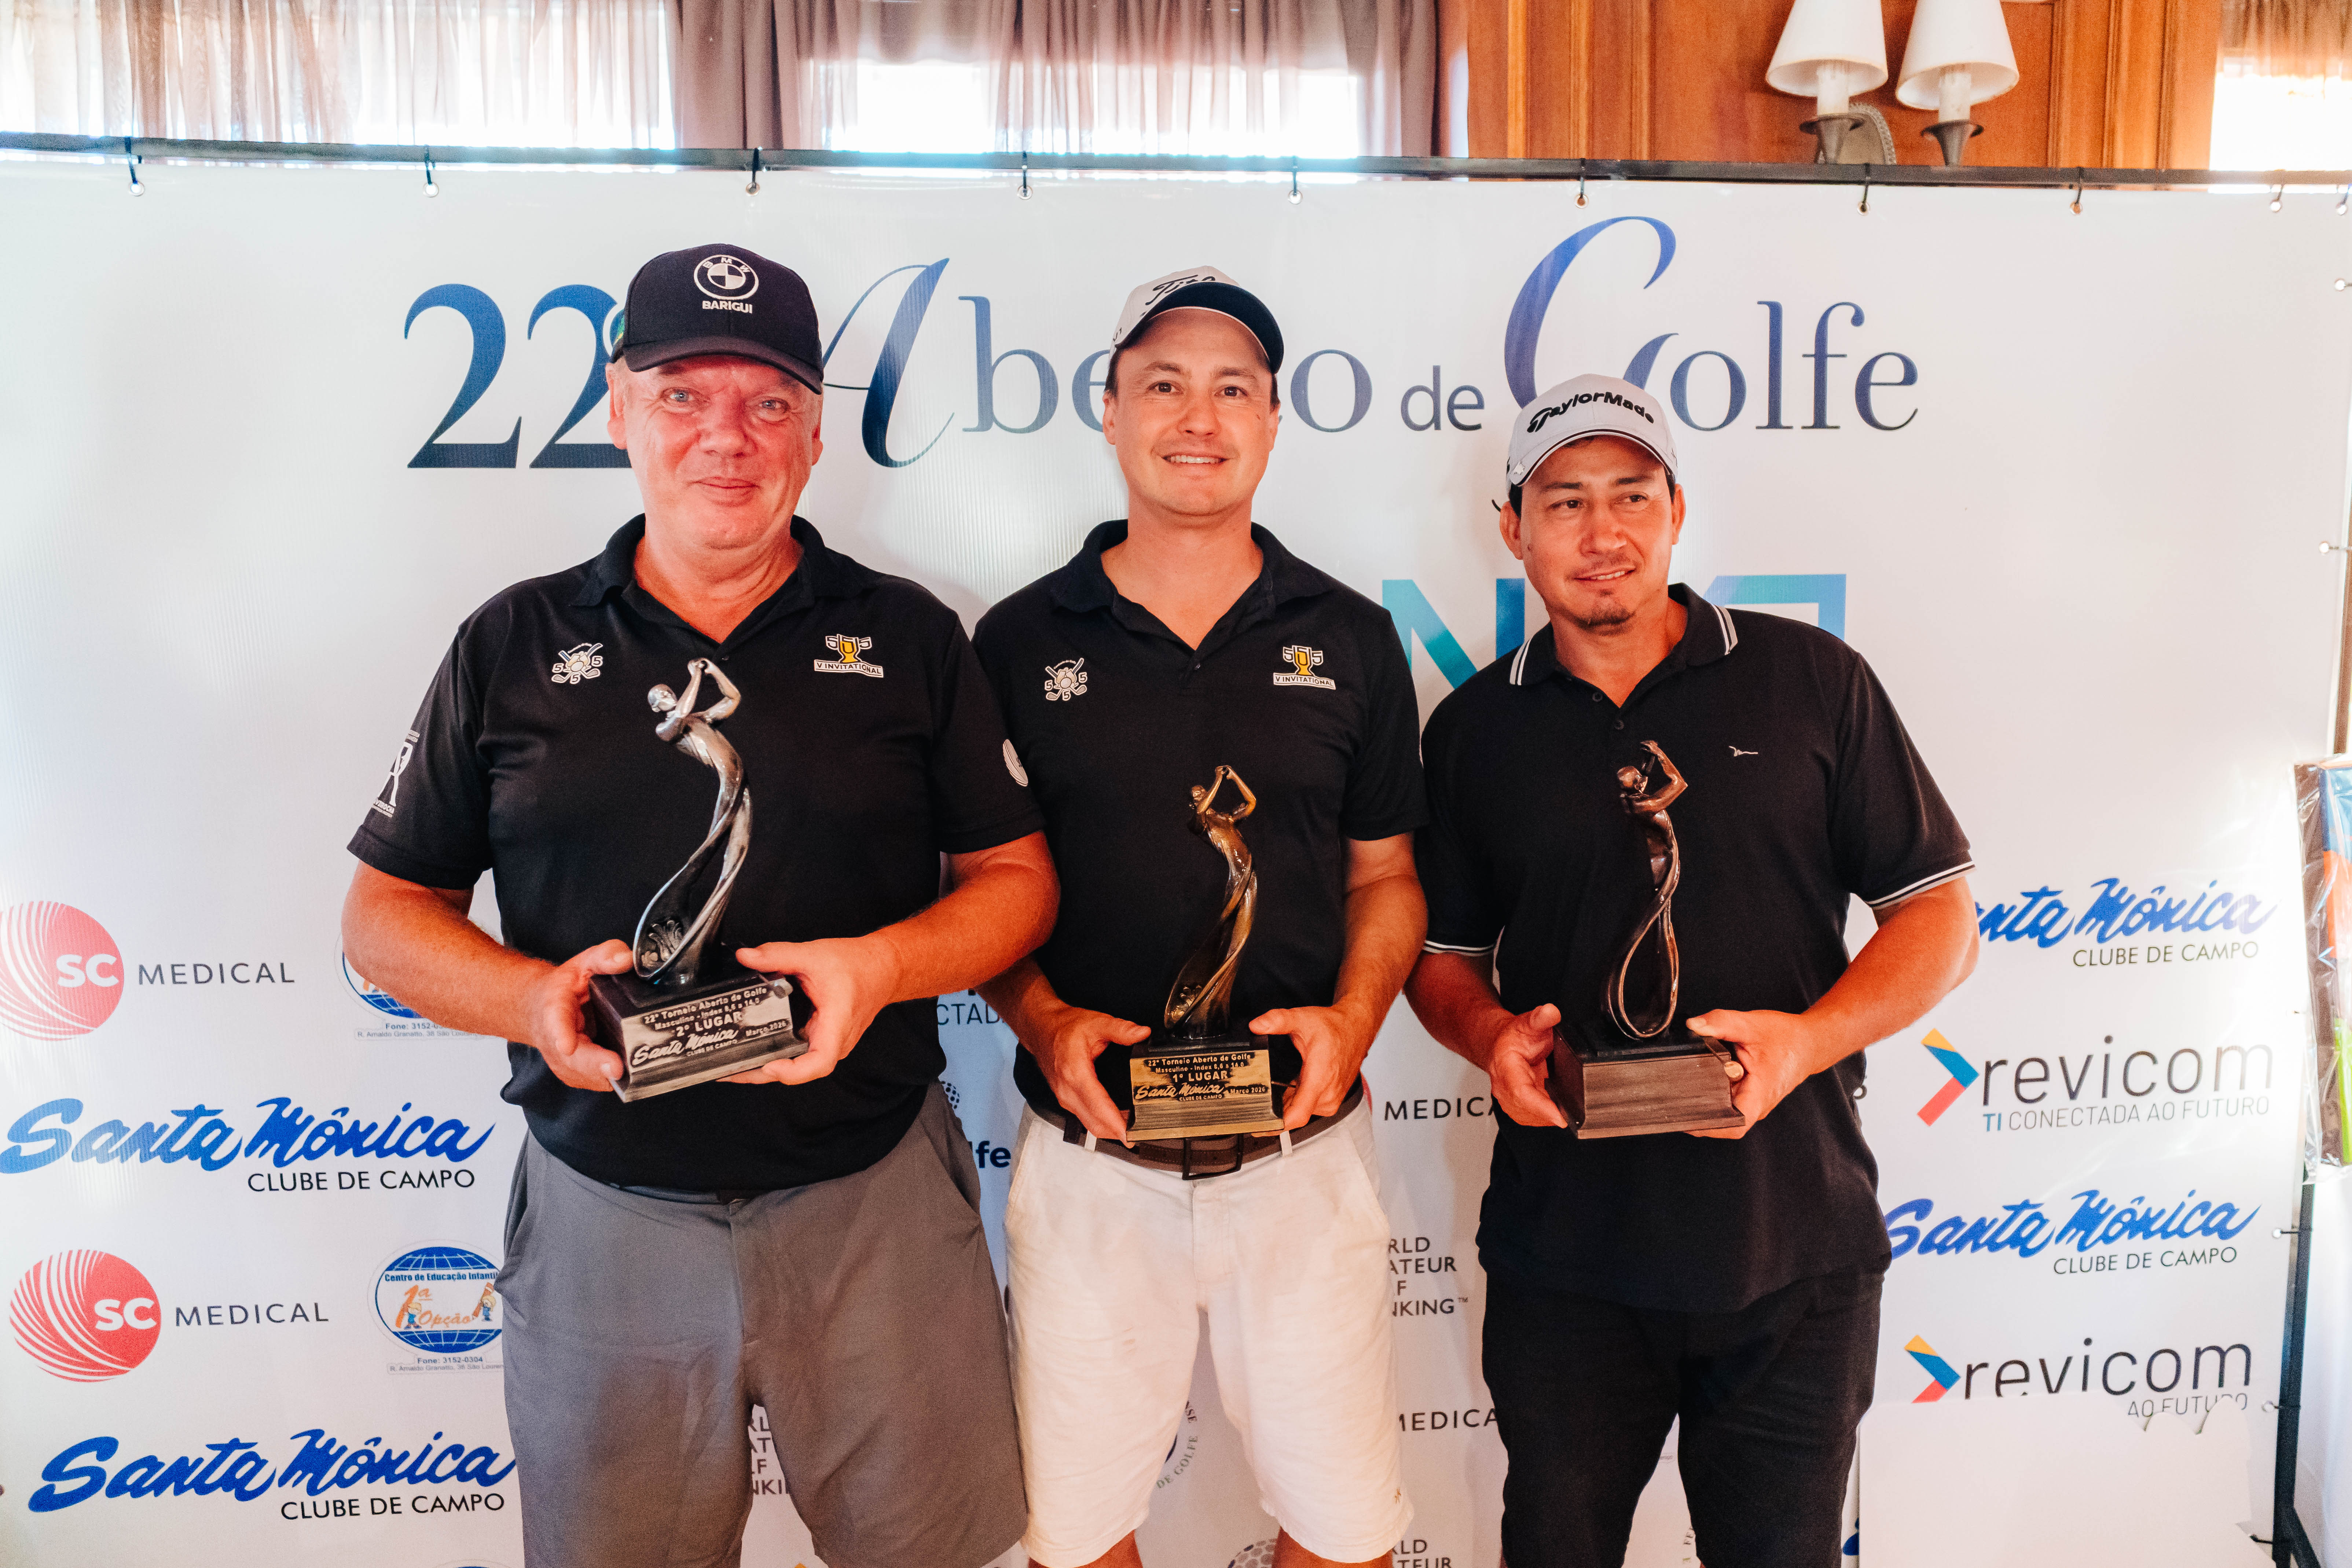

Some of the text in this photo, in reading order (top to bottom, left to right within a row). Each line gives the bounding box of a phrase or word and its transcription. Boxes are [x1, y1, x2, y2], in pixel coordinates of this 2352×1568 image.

[702, 257, 751, 272] BMW
[702, 301, 752, 313] BARIGUI
[404, 283, 632, 469] 22
[1400, 366, 1485, 431] de
[1527, 391, 1654, 433] TaylorMade
[825, 663, 881, 674] INVITATIONAL
[1283, 676, 1334, 687] INVITATIONAL
[1976, 878, 2282, 948] nta Mônica
[2073, 941, 2259, 968] CLUBE DE CAMPO
[57, 954, 295, 987] SC MEDICAL
[661, 1006, 697, 1019] Torneio
[699, 998, 729, 1010] Aberto
[730, 994, 742, 1003] de
[744, 987, 767, 998] Golfe
[654, 1016, 695, 1030] Masculino
[701, 1008, 723, 1019] Index
[695, 1011, 743, 1032] LUGAR
[770, 1021, 787, 1030] 2026
[632, 1040, 684, 1065] Santa
[1188, 1071, 1228, 1081] LUGAR
[1982, 1035, 2273, 1106] revicom
[1135, 1085, 1177, 1099] Santa
[1384, 1097, 1494, 1121] MEDIC
[1983, 1096, 2269, 1131] TI CONECTADA AO FUTURO
[0, 1097, 495, 1173] Santa Mônica
[248, 1168, 475, 1192] CLUBE DE CAMPO
[2056, 1189, 2262, 1253] Mônica
[2054, 1246, 2238, 1274] CLUBE DE CAMPO
[427, 1272, 466, 1282] Educação
[95, 1298, 329, 1331] SC MEDICAL
[419, 1311, 470, 1329] Opção
[2128, 1393, 2248, 1417] AO FUTUO
[1399, 1408, 1497, 1431] EDICA
[28, 1429, 516, 1513] Santa Mônica
[281, 1492, 504, 1520] CLUBE DE CAMPO
